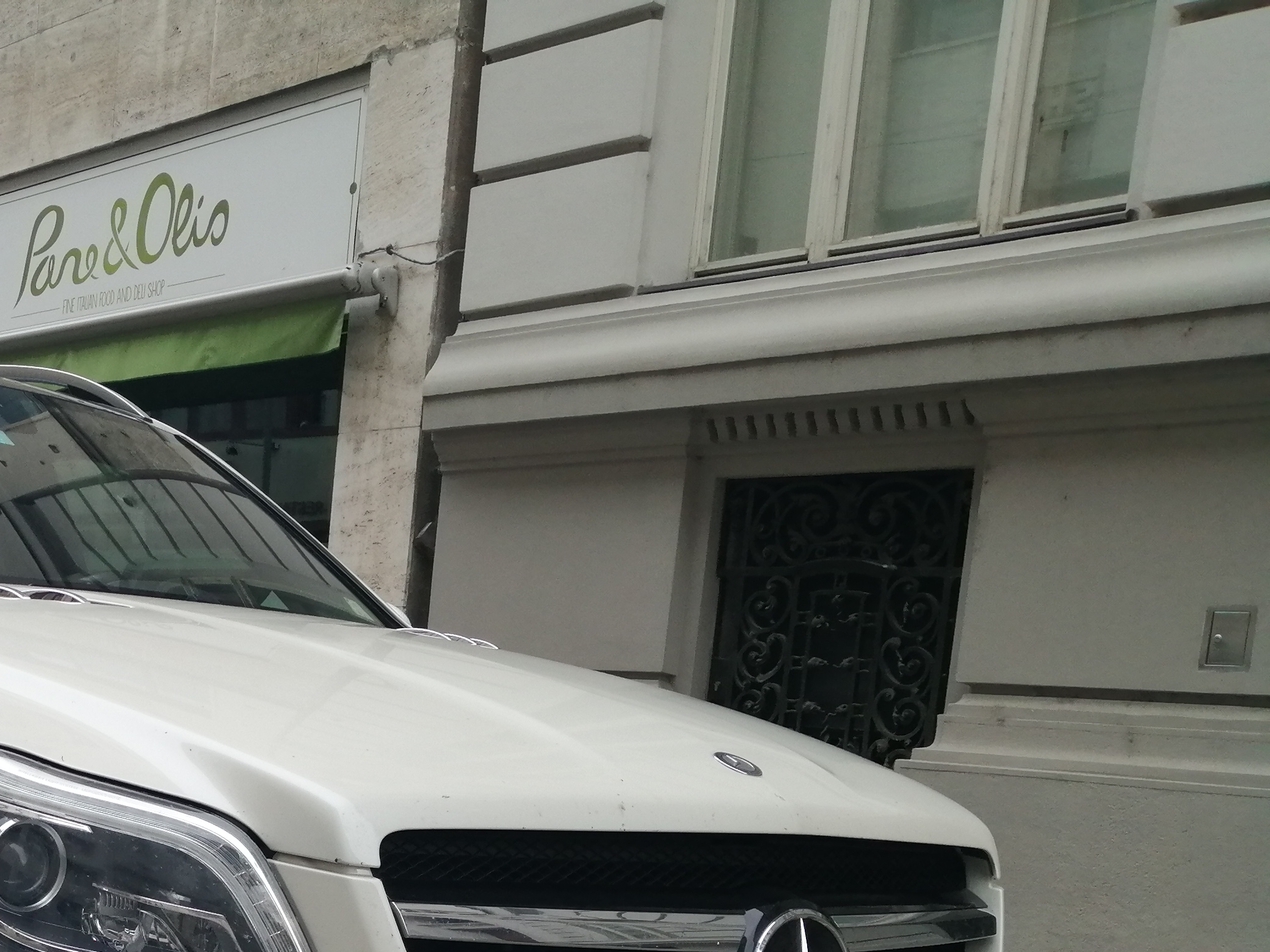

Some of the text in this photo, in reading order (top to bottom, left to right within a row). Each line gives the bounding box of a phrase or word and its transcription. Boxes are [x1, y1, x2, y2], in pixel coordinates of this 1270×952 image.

[62, 298, 75, 314] FINE
[99, 290, 115, 308] FOOD
[116, 287, 132, 303] AND
[133, 283, 146, 300] DELI
[147, 279, 165, 298] SHOP
